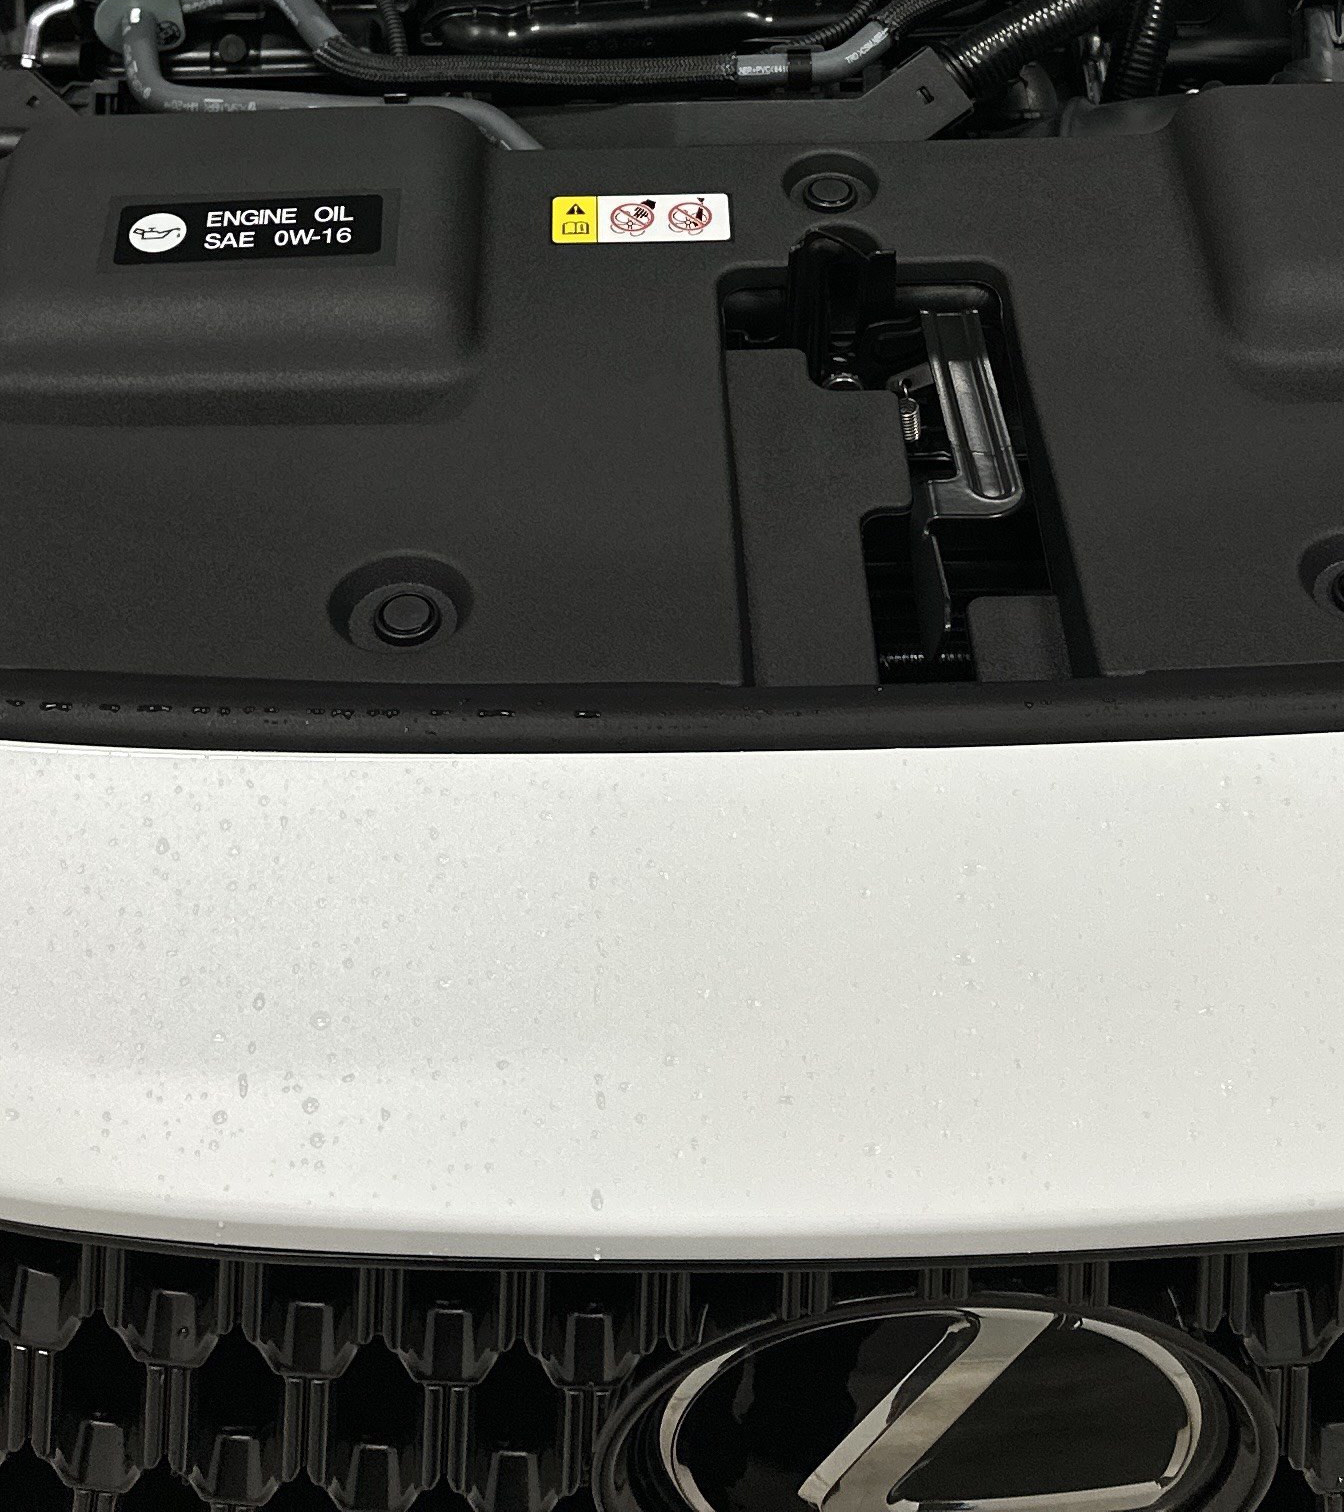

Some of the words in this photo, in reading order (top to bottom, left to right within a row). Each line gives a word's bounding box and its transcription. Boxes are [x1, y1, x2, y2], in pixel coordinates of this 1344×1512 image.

[206, 207, 298, 228] ENGINE
[314, 205, 354, 223] OIL
[204, 232, 256, 250] SAE
[274, 227, 352, 247] 0W-16
